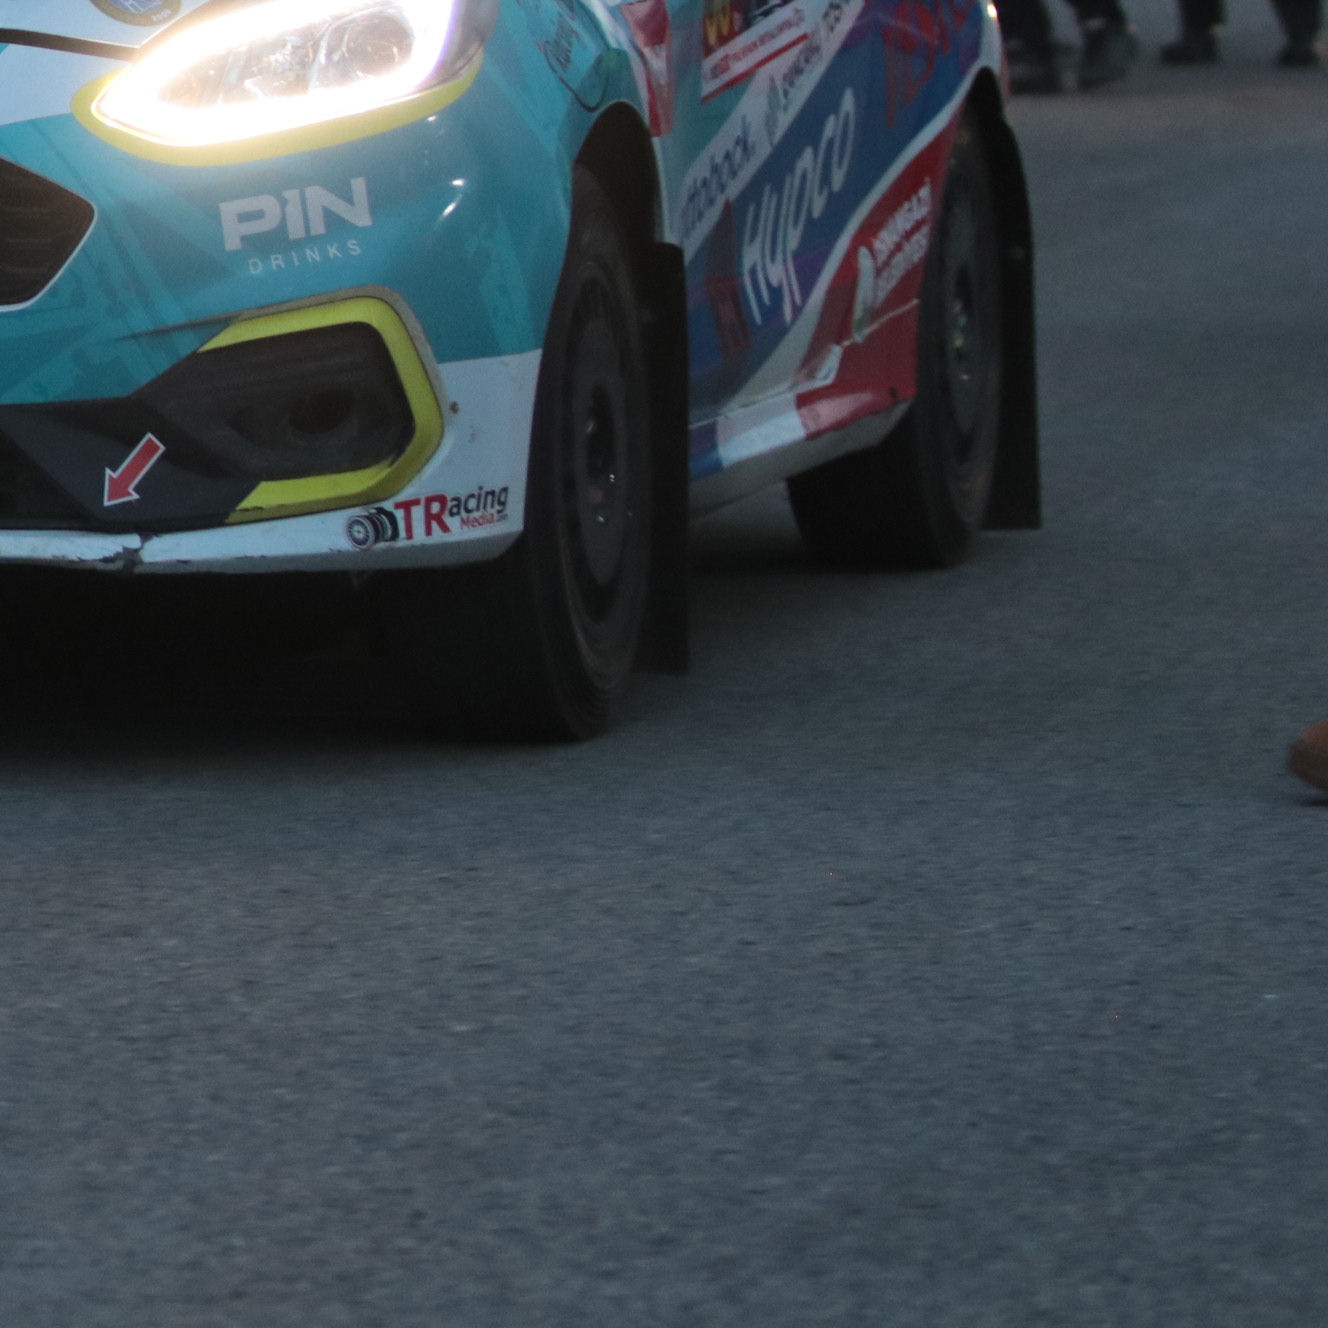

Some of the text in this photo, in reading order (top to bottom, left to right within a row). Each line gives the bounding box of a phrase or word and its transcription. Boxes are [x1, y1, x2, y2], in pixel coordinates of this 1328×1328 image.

[218, 176, 373, 252] PIN
[742, 86, 855, 327] Hypco
[248, 239, 362, 274] DRINKS
